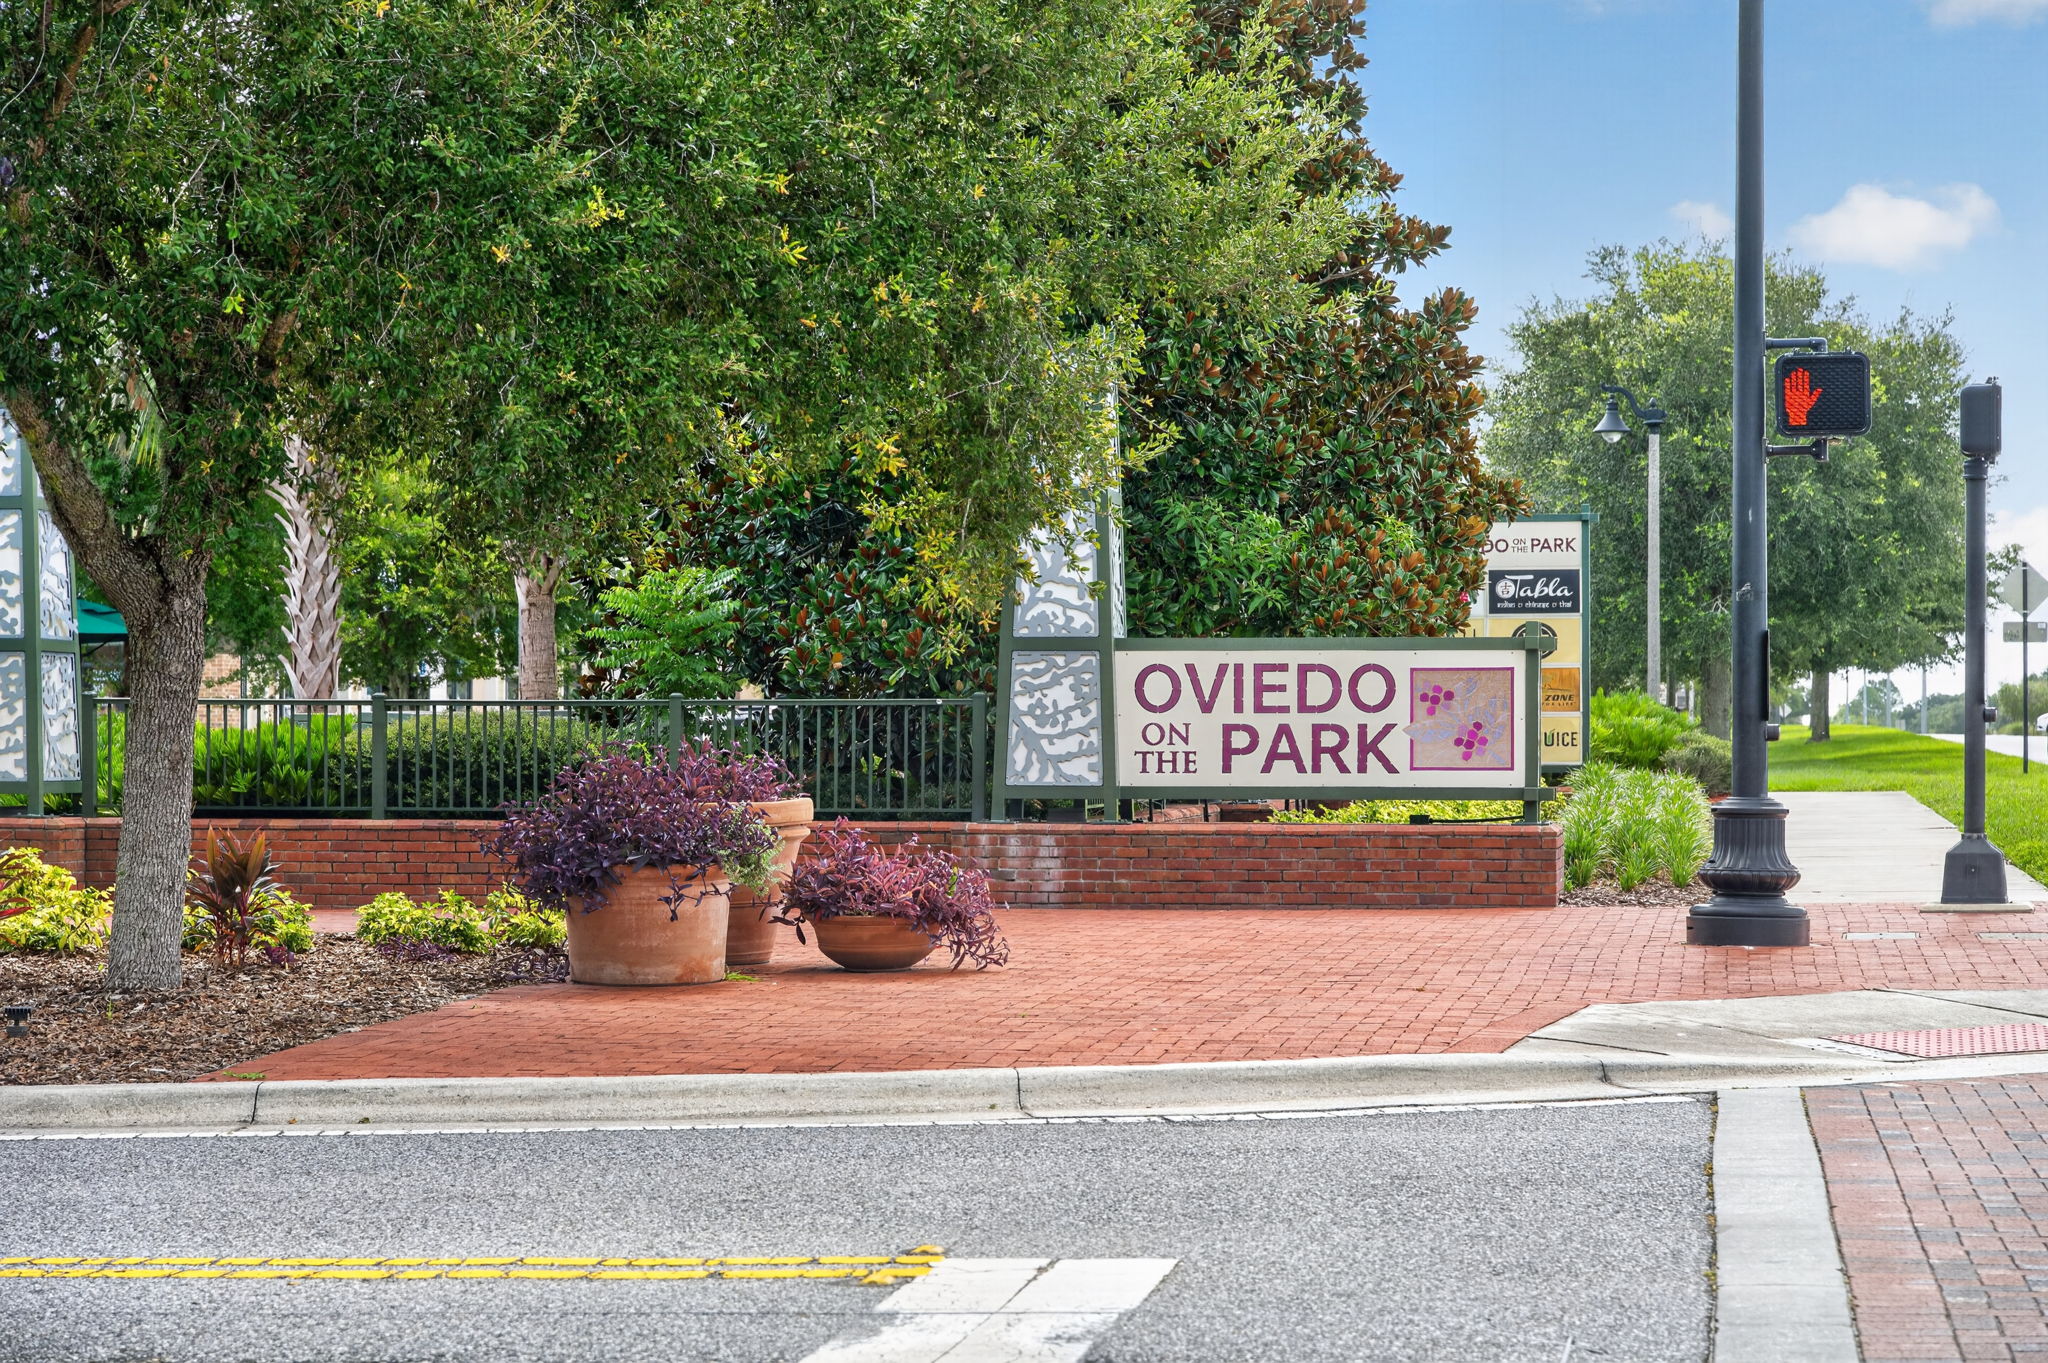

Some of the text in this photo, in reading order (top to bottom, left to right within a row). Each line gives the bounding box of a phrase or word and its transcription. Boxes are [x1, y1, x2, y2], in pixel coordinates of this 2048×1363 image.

[1530, 537, 1577, 553] PARK
[1504, 574, 1573, 599] Tabla
[1134, 663, 1397, 714] OVIEDO
[1544, 694, 1575, 702] ZONE
[1141, 722, 1191, 746] ON
[1544, 731, 1578, 747] UICE
[1221, 723, 1401, 774] PARK
[1134, 750, 1198, 774] THE
